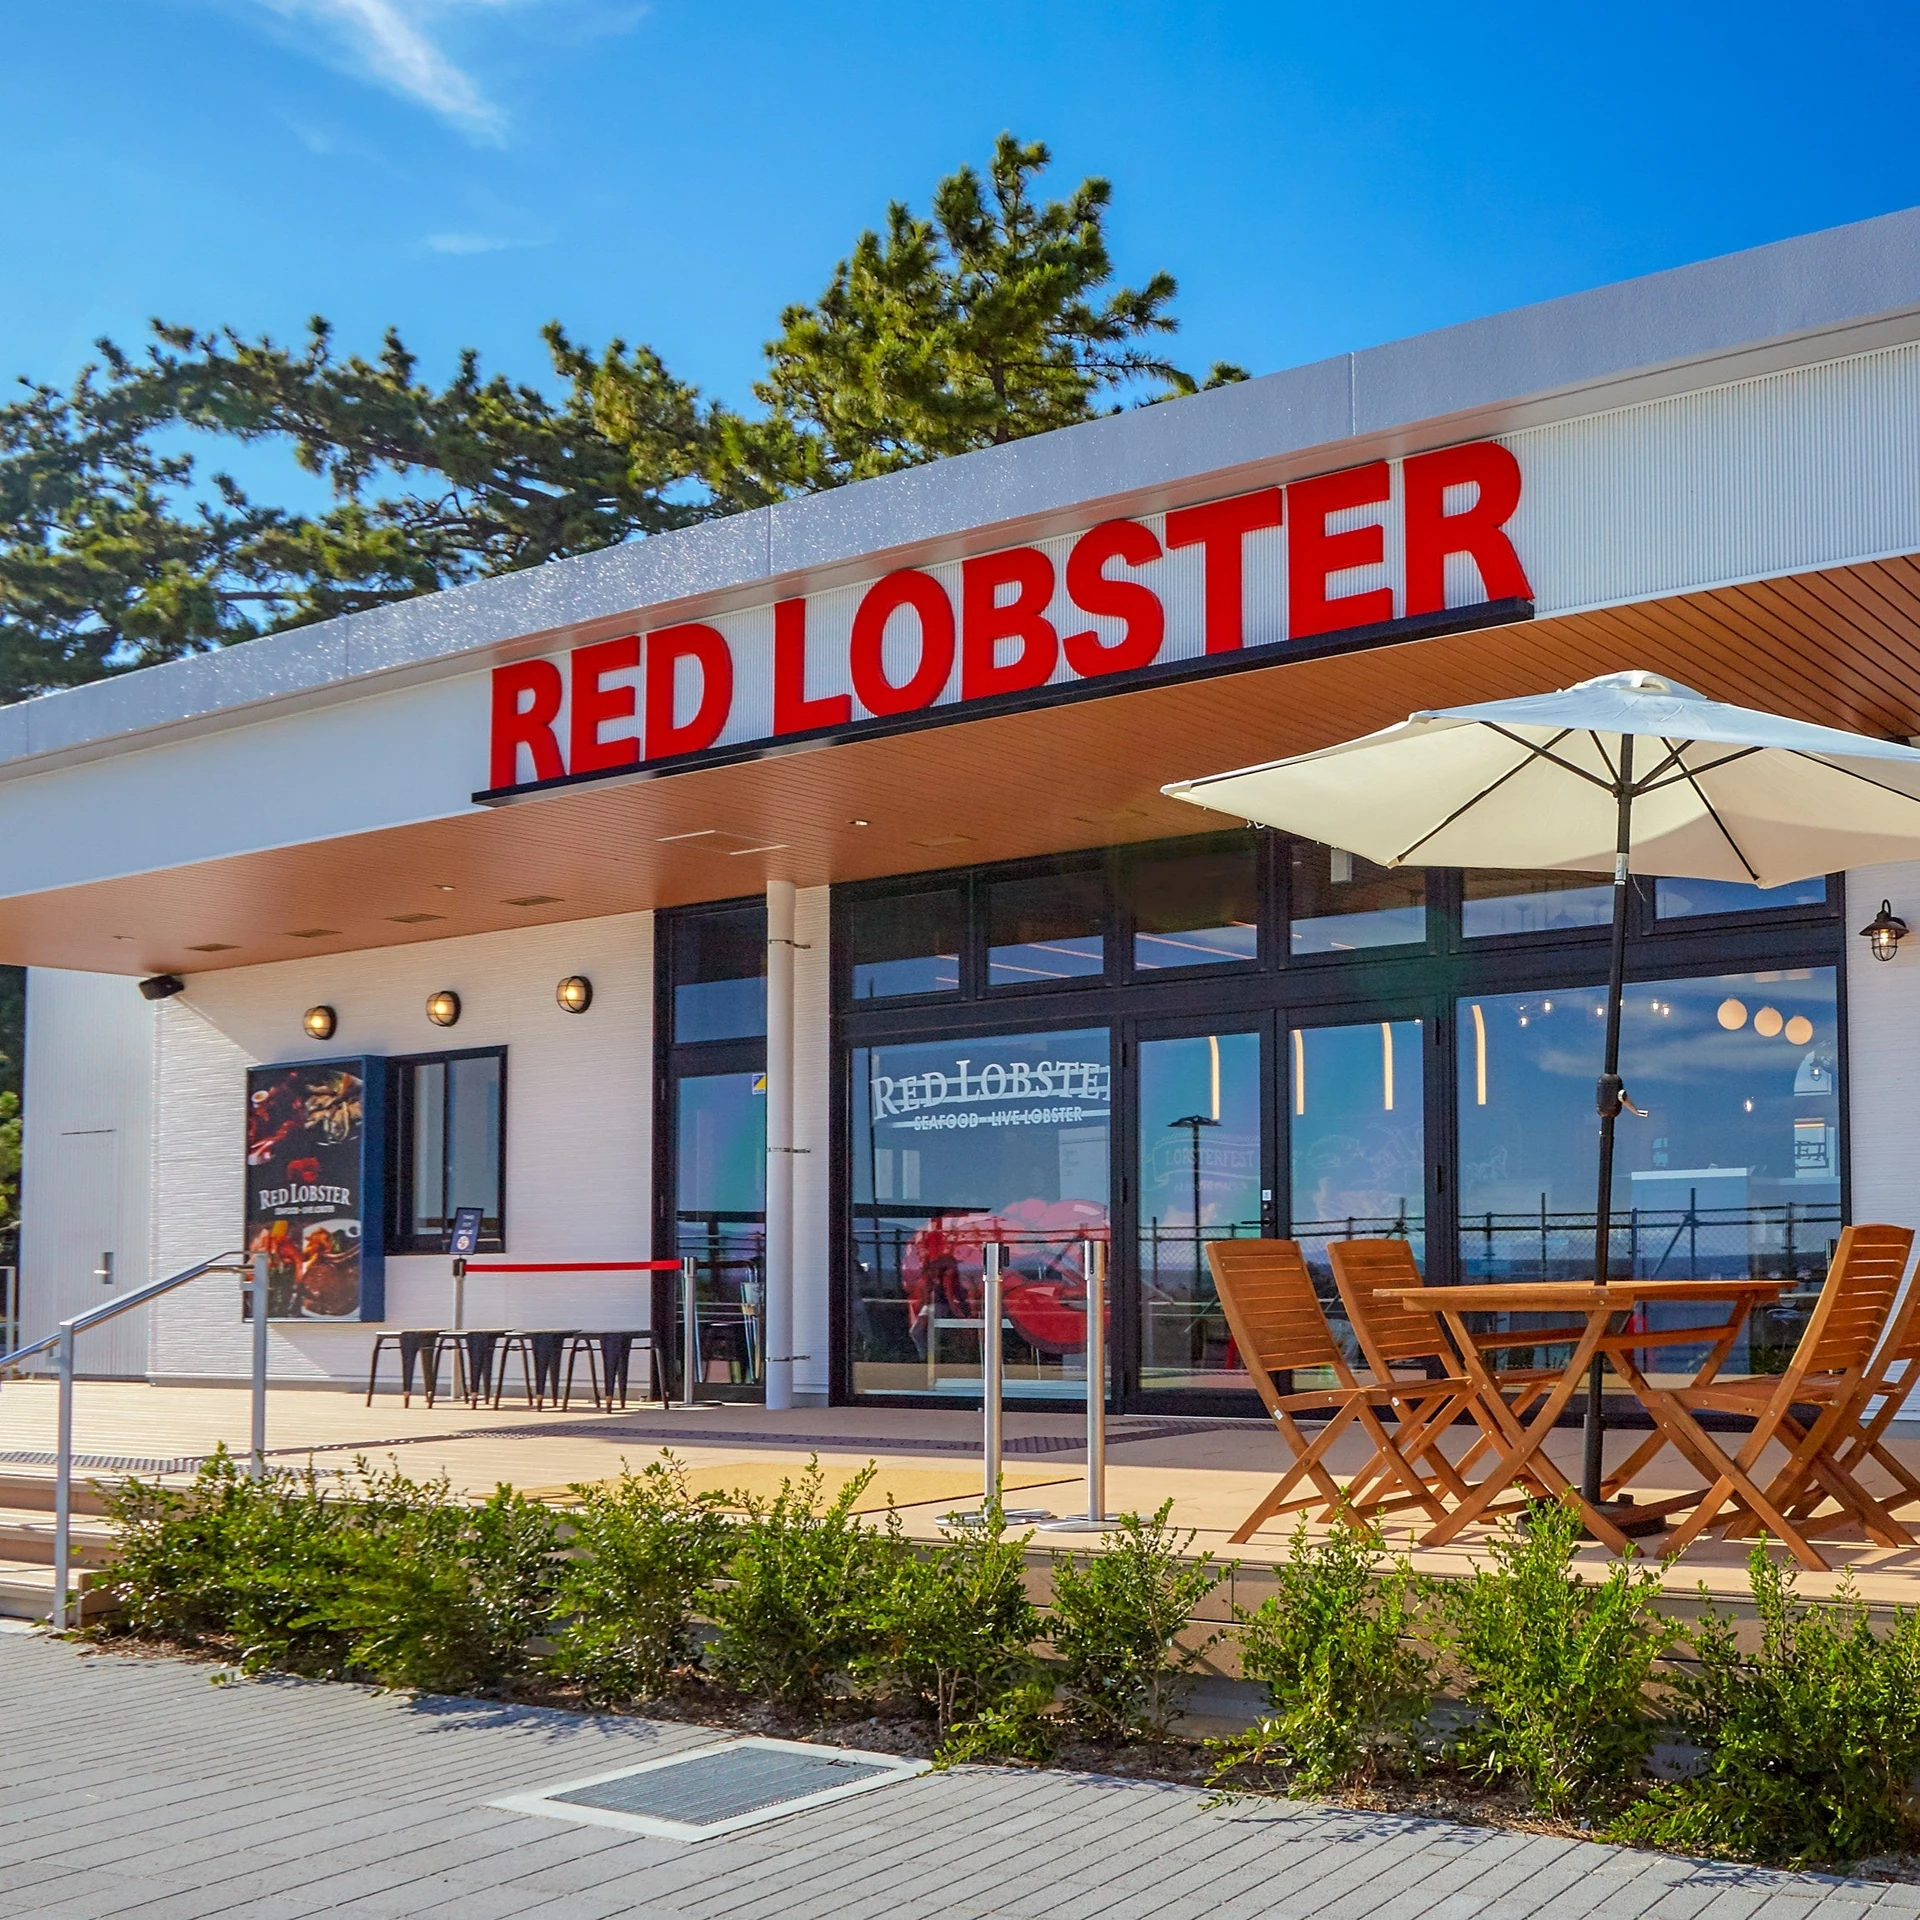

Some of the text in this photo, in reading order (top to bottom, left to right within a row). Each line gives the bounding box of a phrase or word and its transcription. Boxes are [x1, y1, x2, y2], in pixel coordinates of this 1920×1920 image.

[489, 441, 1534, 791] RED LOBSTER
[870, 1071, 948, 1120] RED
[913, 1106, 1083, 1131] SEAFOOD LIVE LOBSTER
[259, 1188, 289, 1211] RED
[290, 1183, 352, 1206] LOBSTER
